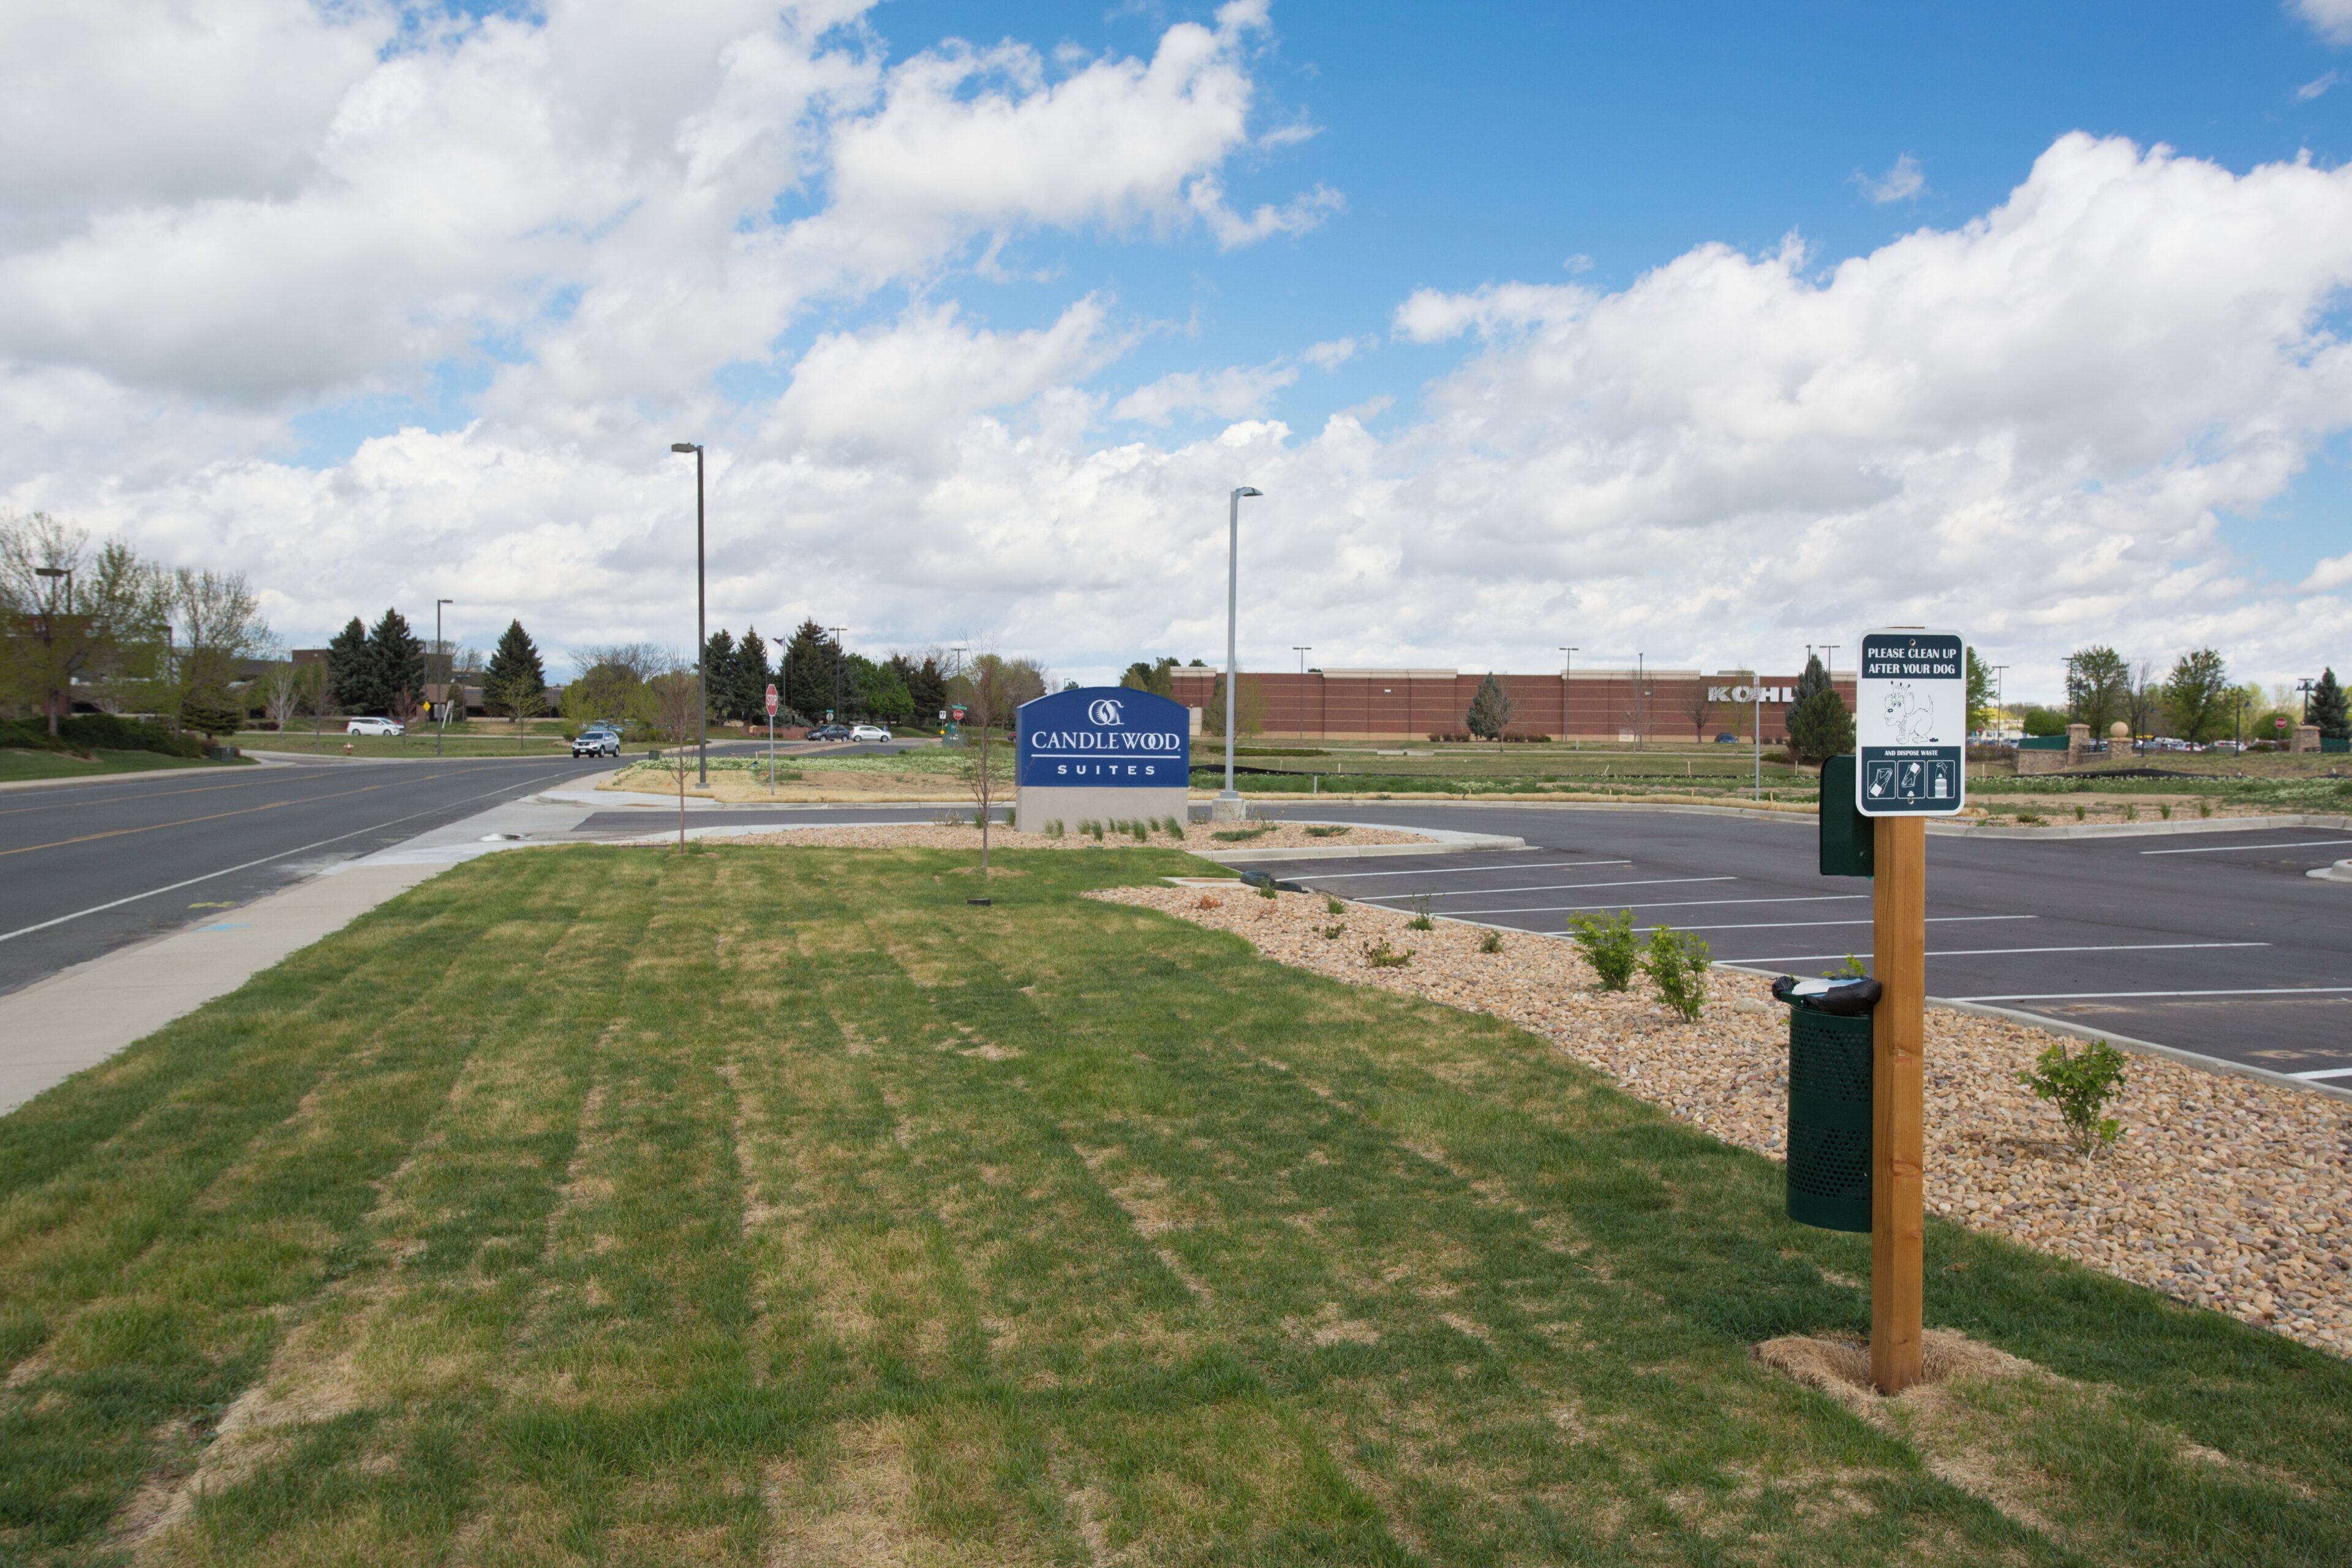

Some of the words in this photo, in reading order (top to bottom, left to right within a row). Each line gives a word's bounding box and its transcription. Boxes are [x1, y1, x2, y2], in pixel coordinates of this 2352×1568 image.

[1868, 648, 1905, 658] PLEASE
[1908, 649, 1939, 658] CLEAN
[1943, 649, 1956, 658] UP
[1869, 663, 1900, 674] AFTER
[1903, 663, 1930, 674] YOUR
[1933, 664, 1955, 674] DOG
[767, 694, 777, 706] STOP
[1031, 731, 1180, 750] CANDLEWOOD
[1058, 765, 1155, 775] SUITES
